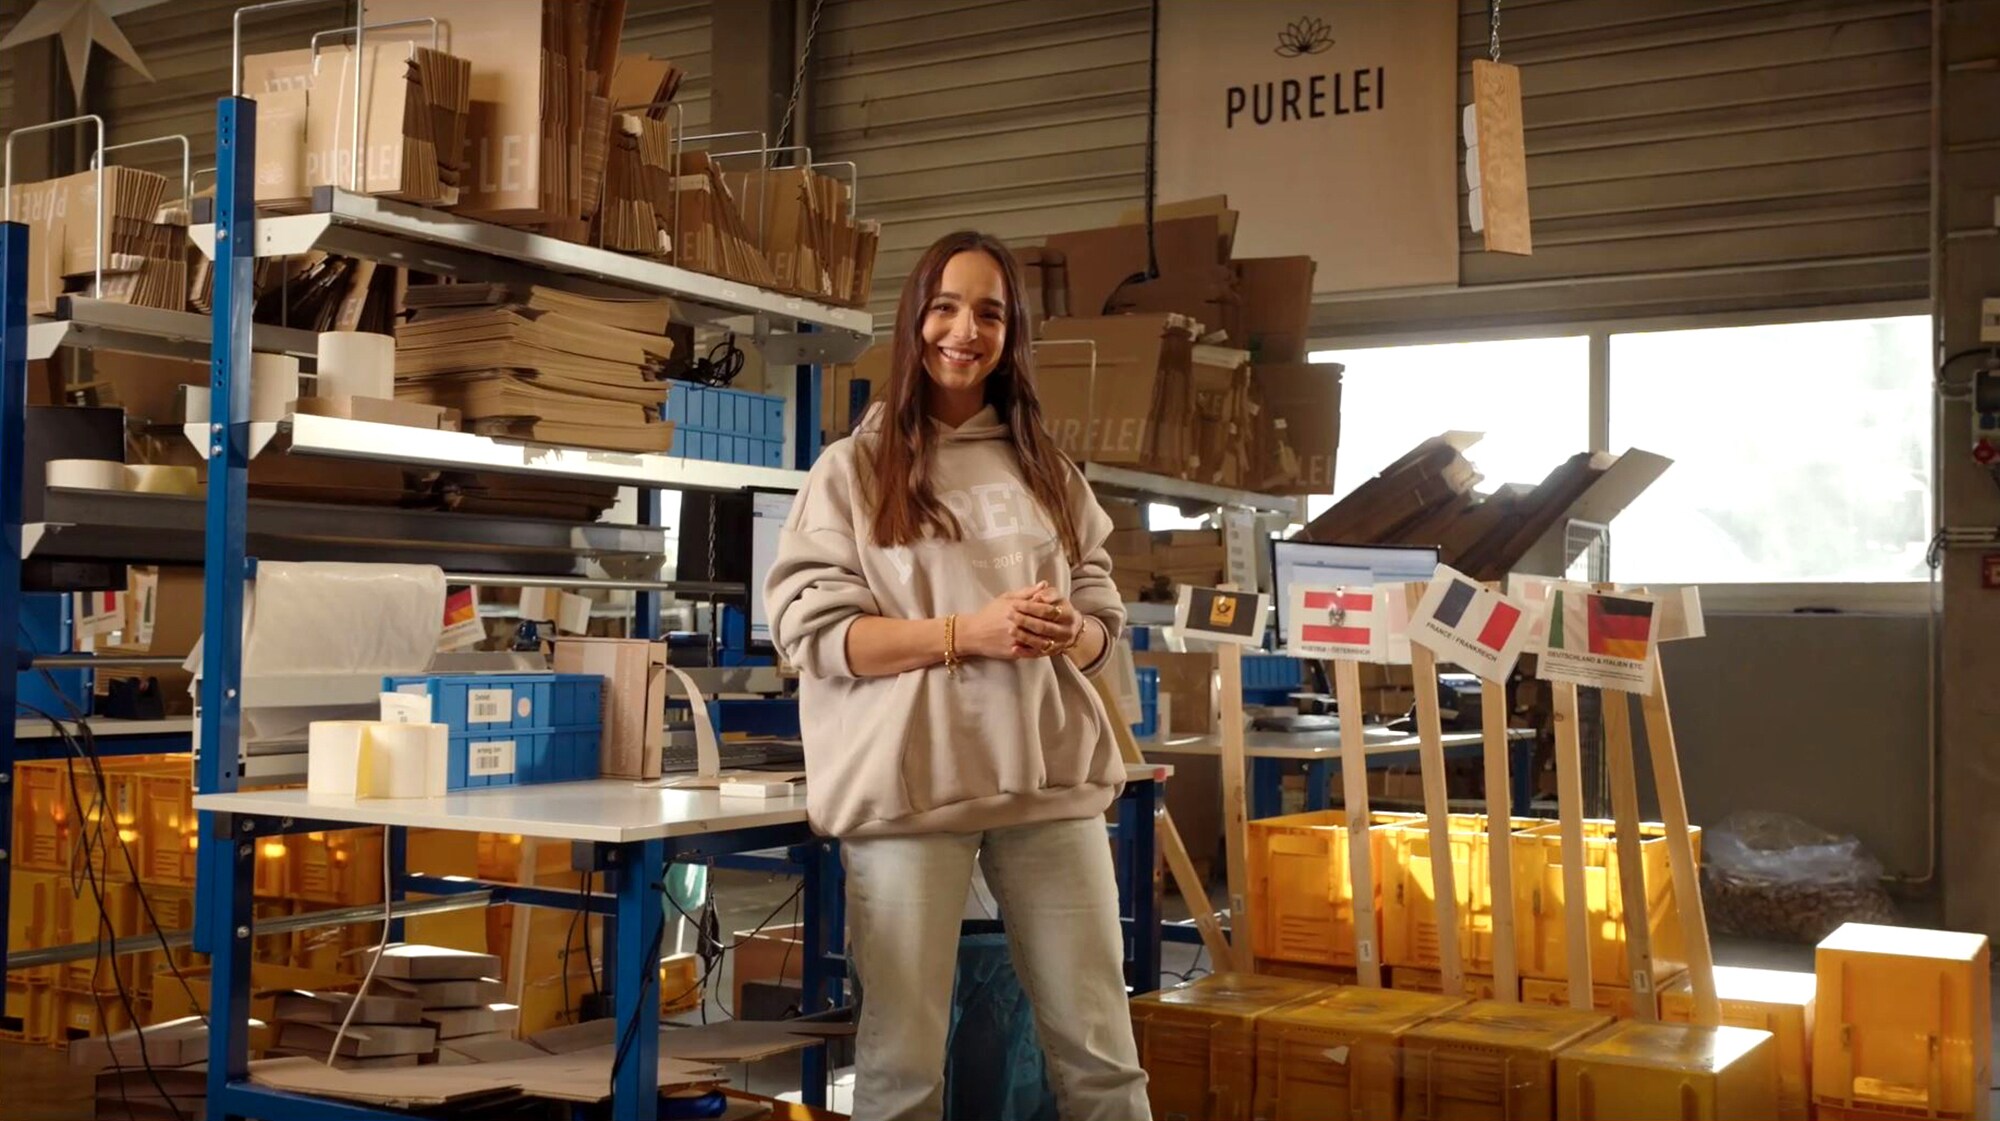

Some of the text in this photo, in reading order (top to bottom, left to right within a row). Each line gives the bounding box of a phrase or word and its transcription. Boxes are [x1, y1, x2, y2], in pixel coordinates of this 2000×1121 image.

[1227, 66, 1384, 129] PURELEI
[993, 551, 1024, 569] 2016
[1425, 621, 1452, 639] FRANCE
[1455, 637, 1498, 662] FRANKREICH
[1547, 650, 1596, 663] DEUTSCHLAND
[1602, 658, 1628, 669] ITALIEN
